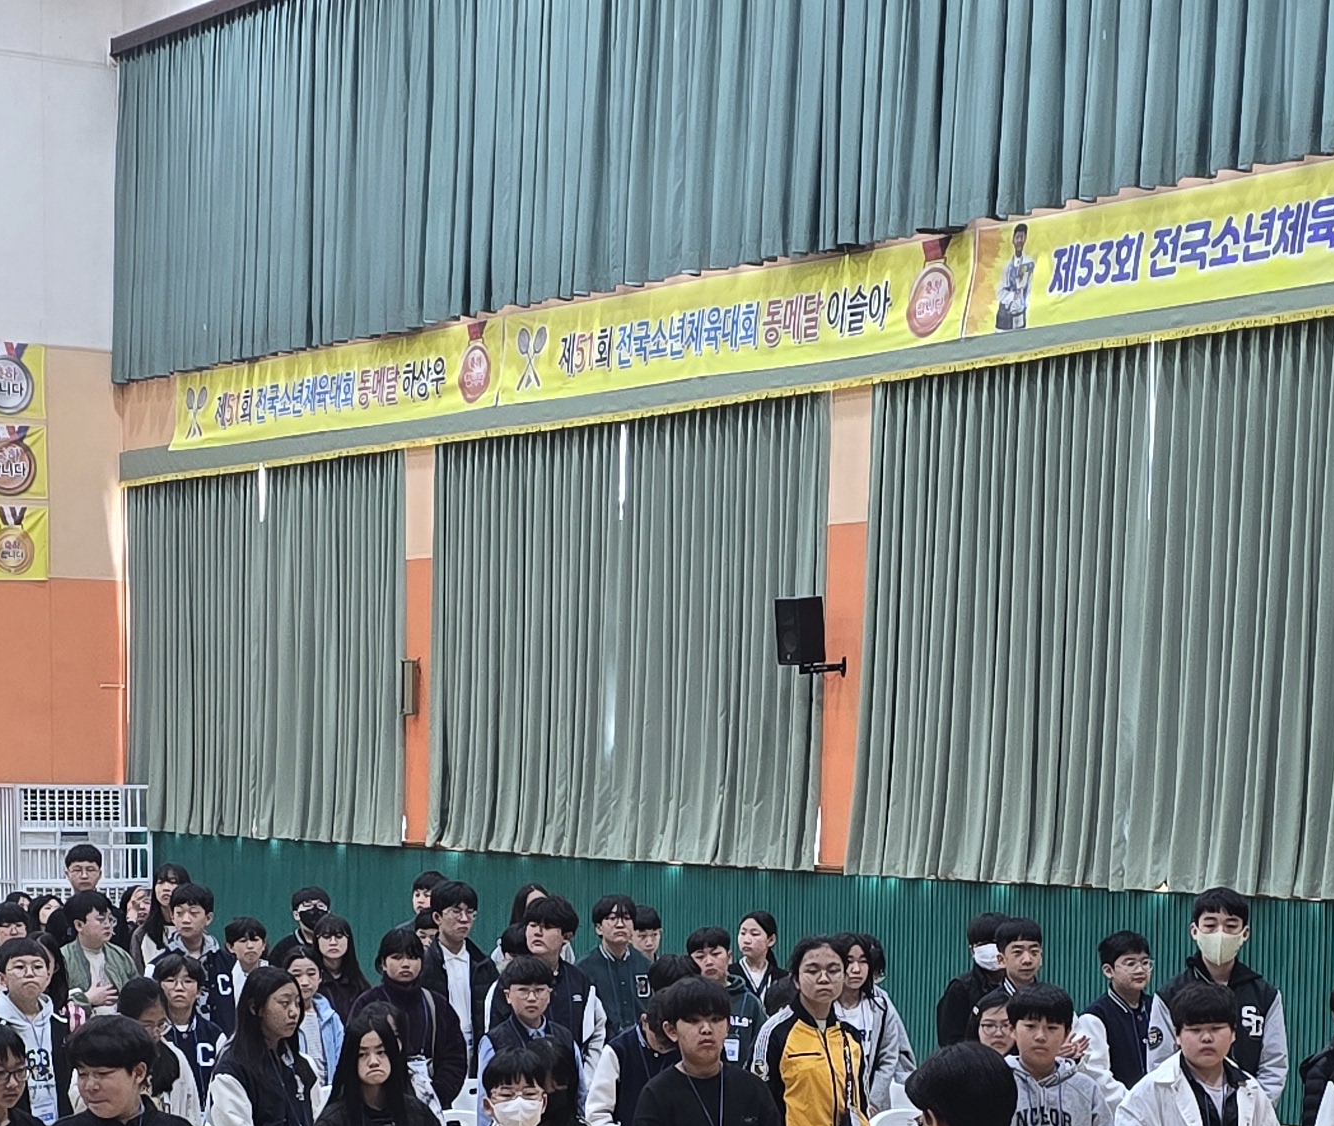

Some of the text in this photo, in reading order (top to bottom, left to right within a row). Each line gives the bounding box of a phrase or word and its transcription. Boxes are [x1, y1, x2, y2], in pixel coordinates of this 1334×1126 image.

[1048, 230, 1145, 294] 제53회
[558, 280, 892, 376] 제51회 전국소년체육대회 동메달 이슬아
[216, 389, 253, 429] 제51회
[255, 370, 356, 422] 전국소년체육대회
[358, 364, 401, 409] 동메달
[217, 974, 232, 995] C
[197, 1042, 215, 1066] C
